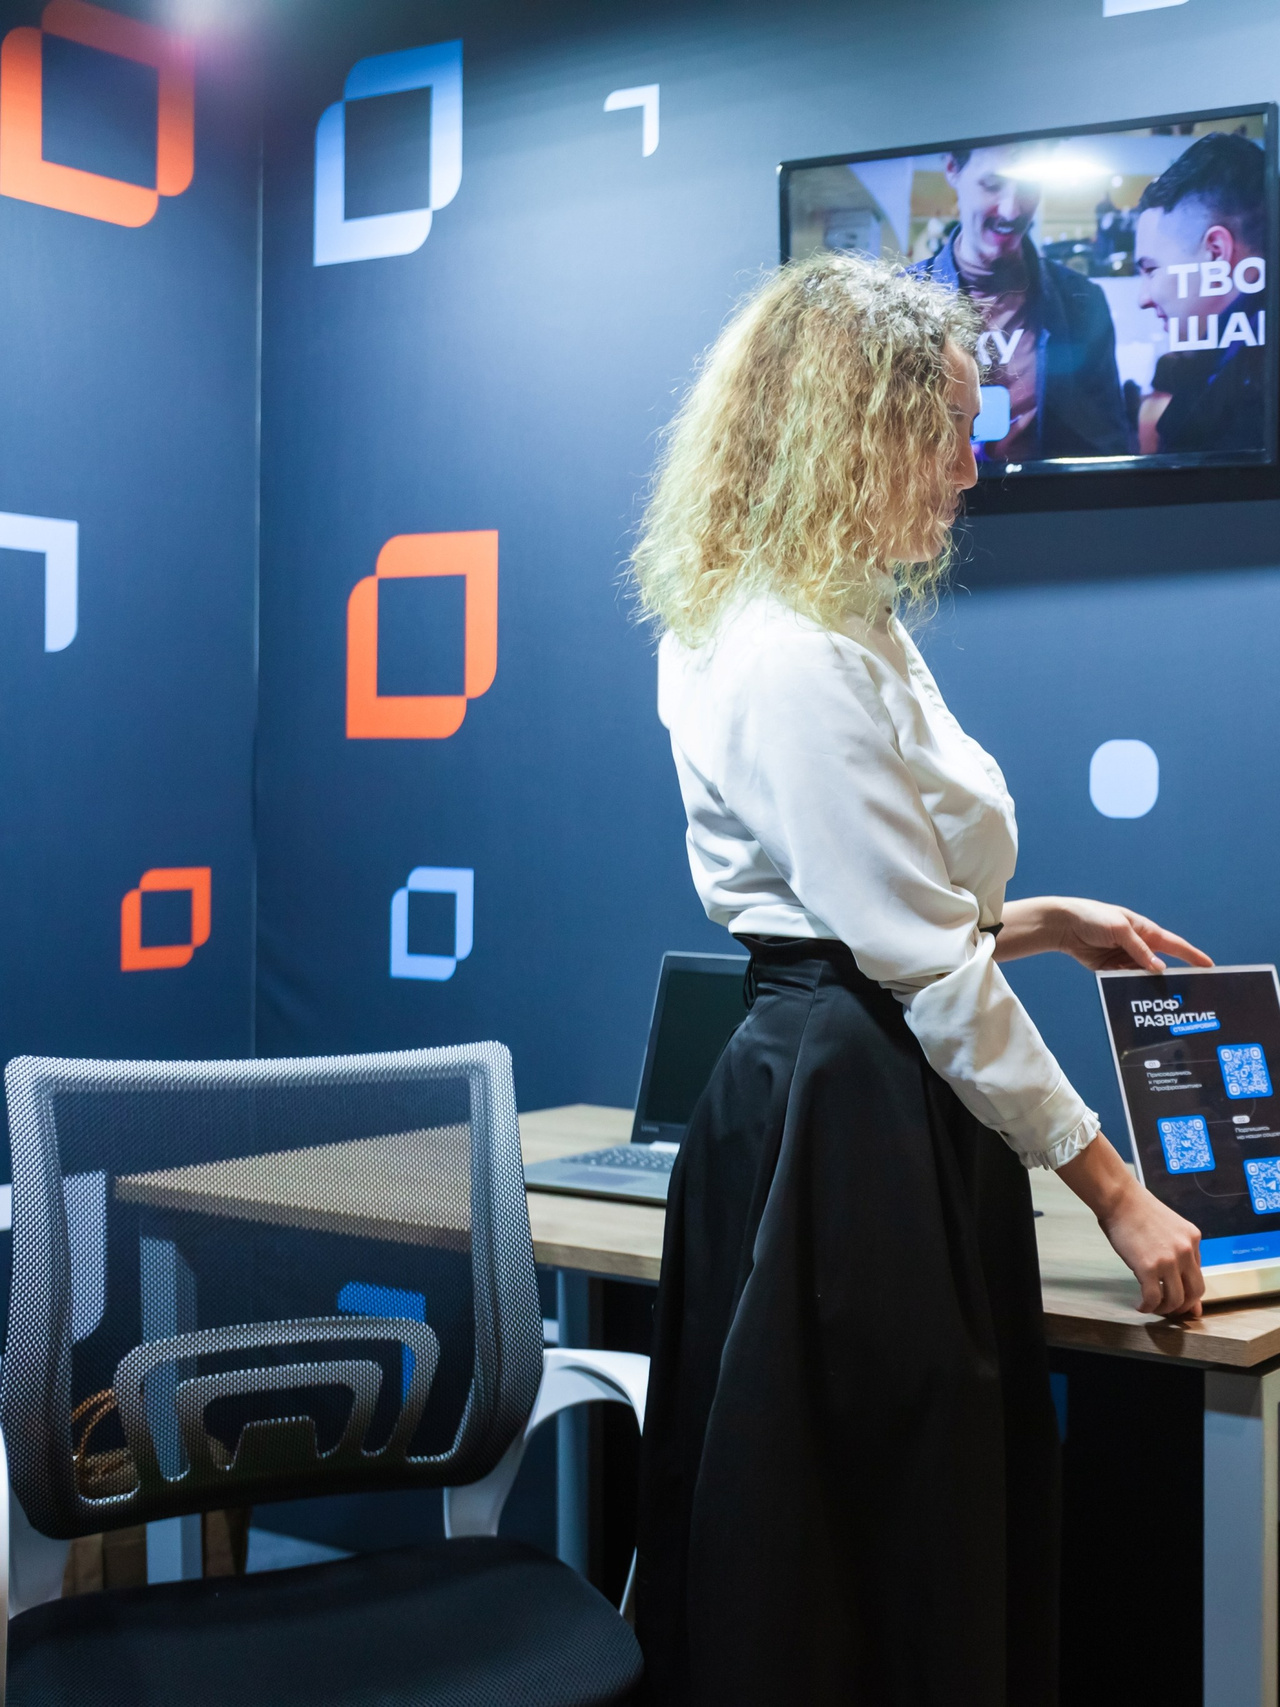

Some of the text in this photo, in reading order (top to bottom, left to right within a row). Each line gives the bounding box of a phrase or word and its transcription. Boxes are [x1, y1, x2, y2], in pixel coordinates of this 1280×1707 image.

[1167, 256, 1266, 298] ТВО
[1131, 999, 1180, 1013] ПРОФ
[1134, 1011, 1217, 1028] РАЗВИТИЕ
